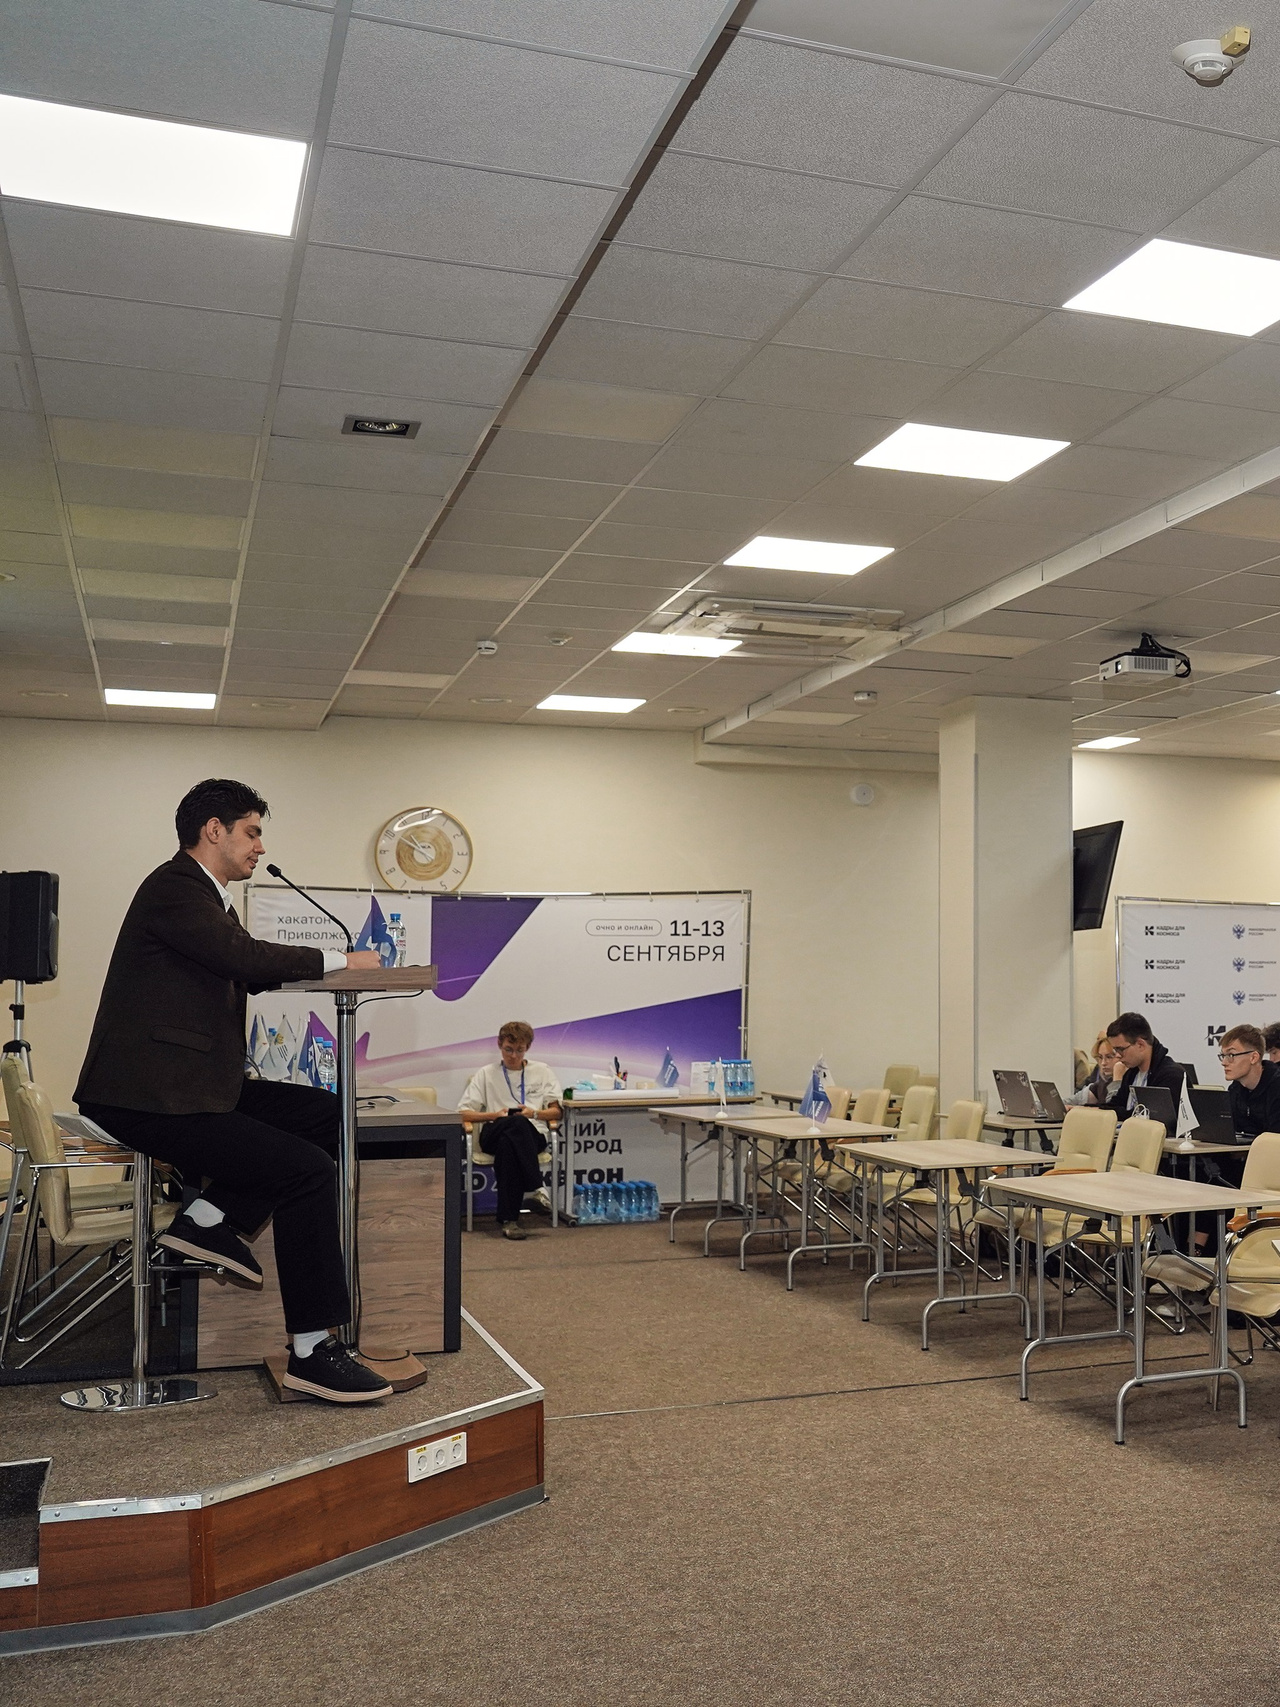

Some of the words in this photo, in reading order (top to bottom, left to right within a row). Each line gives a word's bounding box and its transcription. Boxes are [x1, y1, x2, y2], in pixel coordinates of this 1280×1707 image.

[277, 915, 331, 925] хакатон
[670, 920, 725, 937] 11-13
[607, 945, 725, 962] СЕНТЯБРЯ
